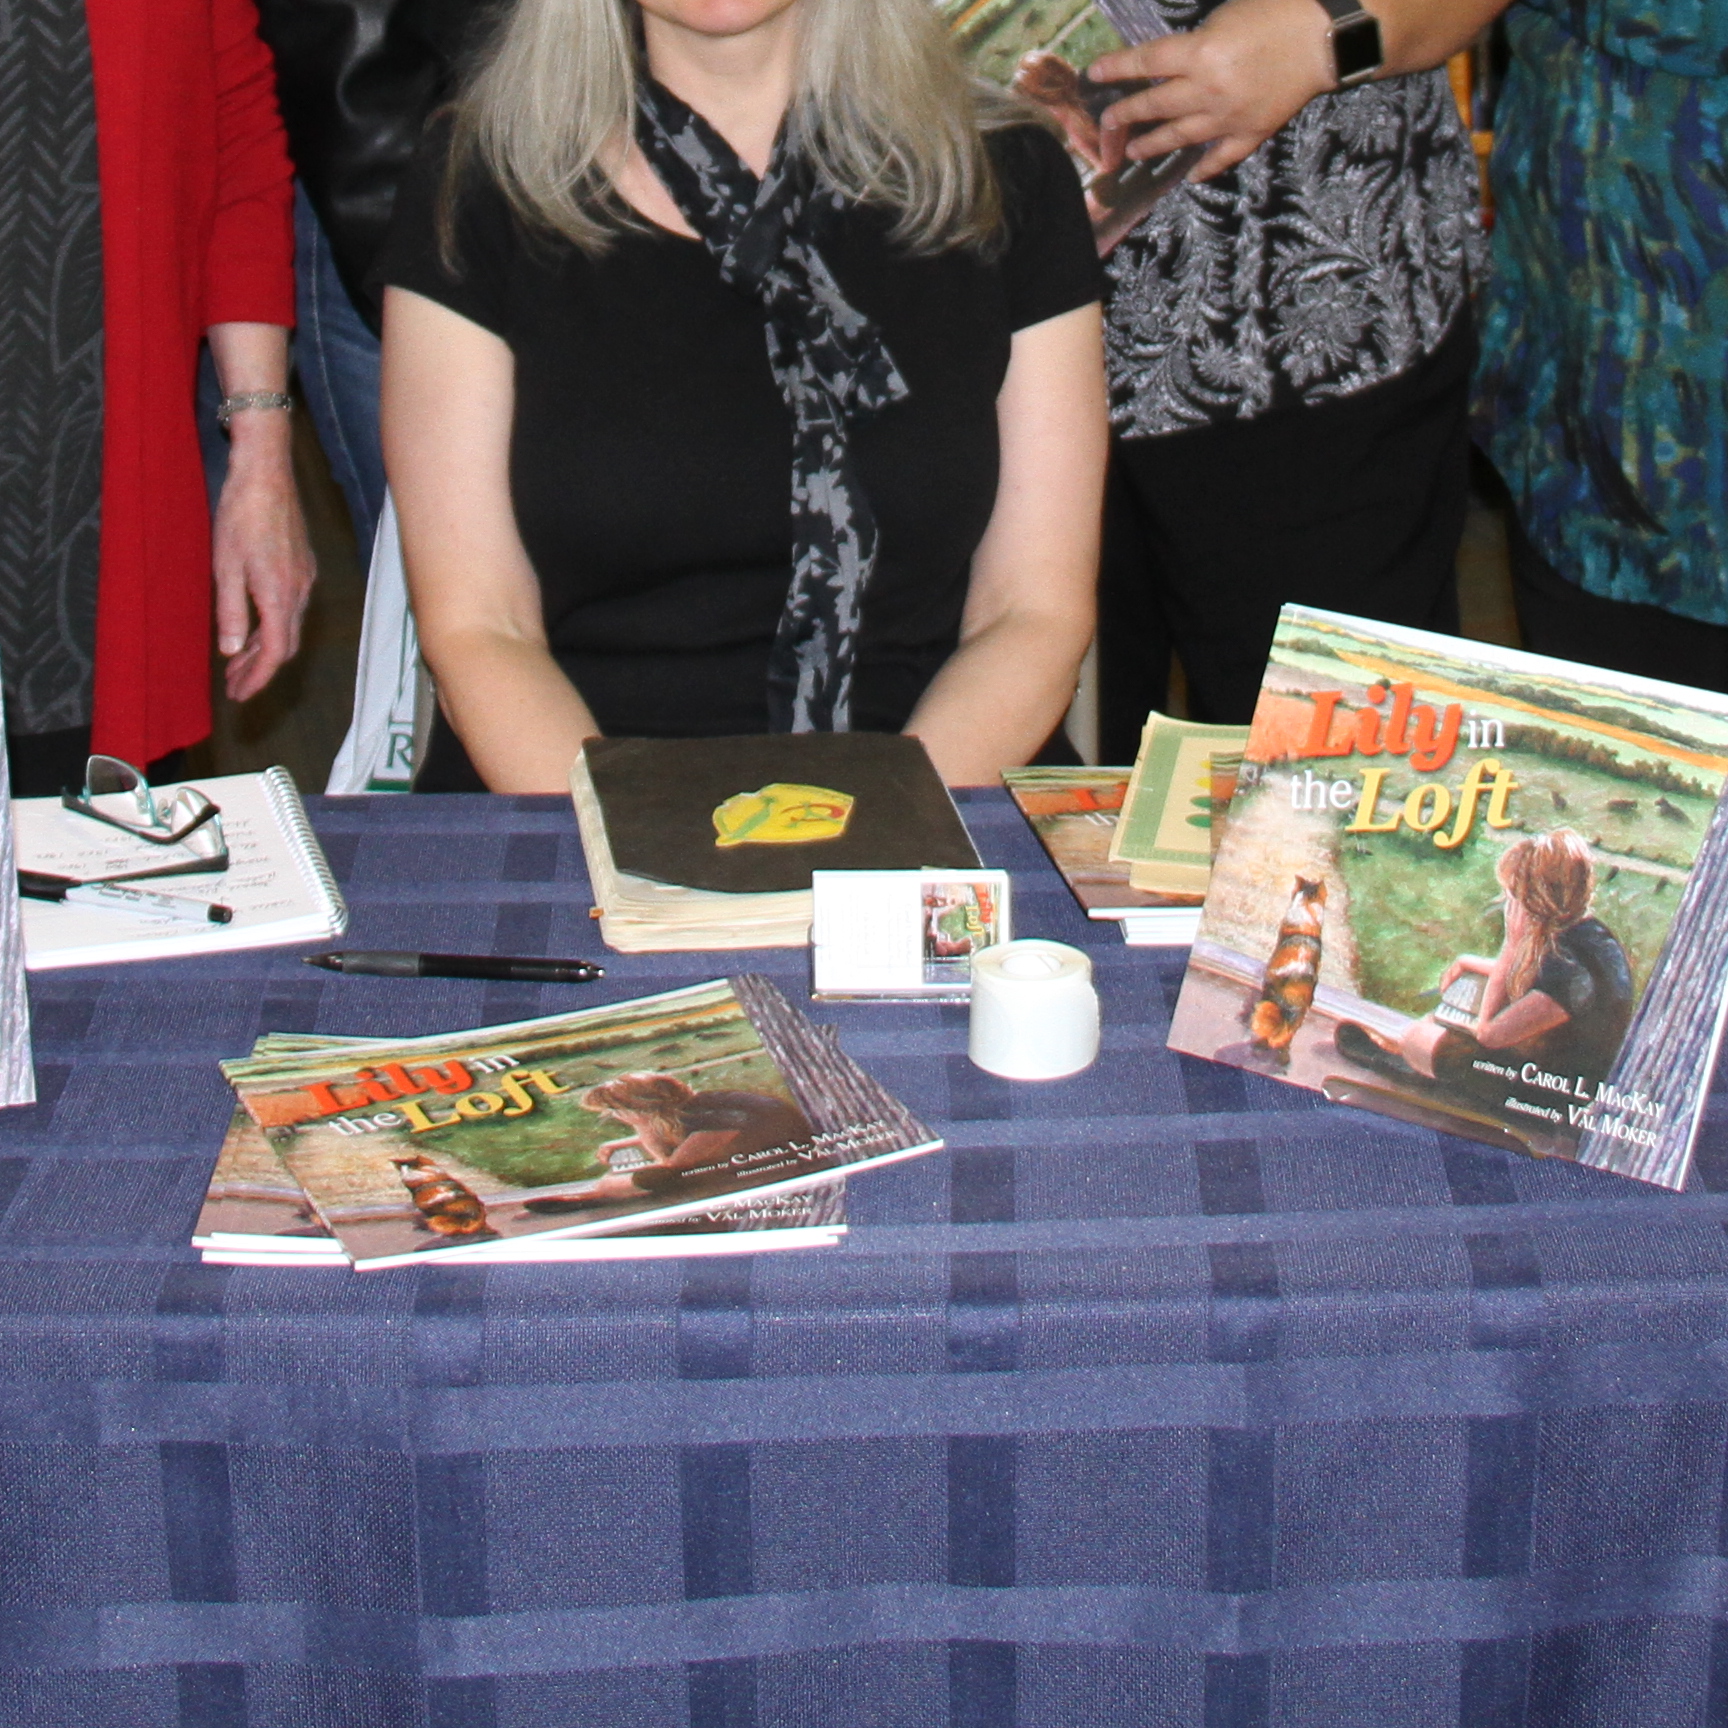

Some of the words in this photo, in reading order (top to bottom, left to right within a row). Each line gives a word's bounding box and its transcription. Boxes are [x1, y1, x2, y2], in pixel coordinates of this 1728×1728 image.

[1297, 682, 1464, 773] Lily
[1467, 708, 1506, 749] in
[1290, 769, 1354, 810] the
[1344, 757, 1520, 850] Loft
[298, 1059, 474, 1116] Lily
[468, 1054, 521, 1074] in
[328, 1111, 403, 1136] the
[390, 1068, 571, 1134] Loft
[1472, 1059, 1505, 1076] written
[1505, 1066, 1519, 1080] by
[1573, 1076, 1592, 1101] L.
[1504, 1095, 1551, 1118] illustrated
[1550, 1108, 1563, 1123] by
[1601, 1113, 1657, 1148] MOKER
[681, 1165, 716, 1177] written
[717, 1160, 731, 1171] by
[788, 1139, 810, 1151] L.
[735, 1160, 784, 1178] illustrated
[785, 1157, 799, 1169] by
[836, 1129, 900, 1152] MOKER
[748, 1207, 814, 1222] MOKER
